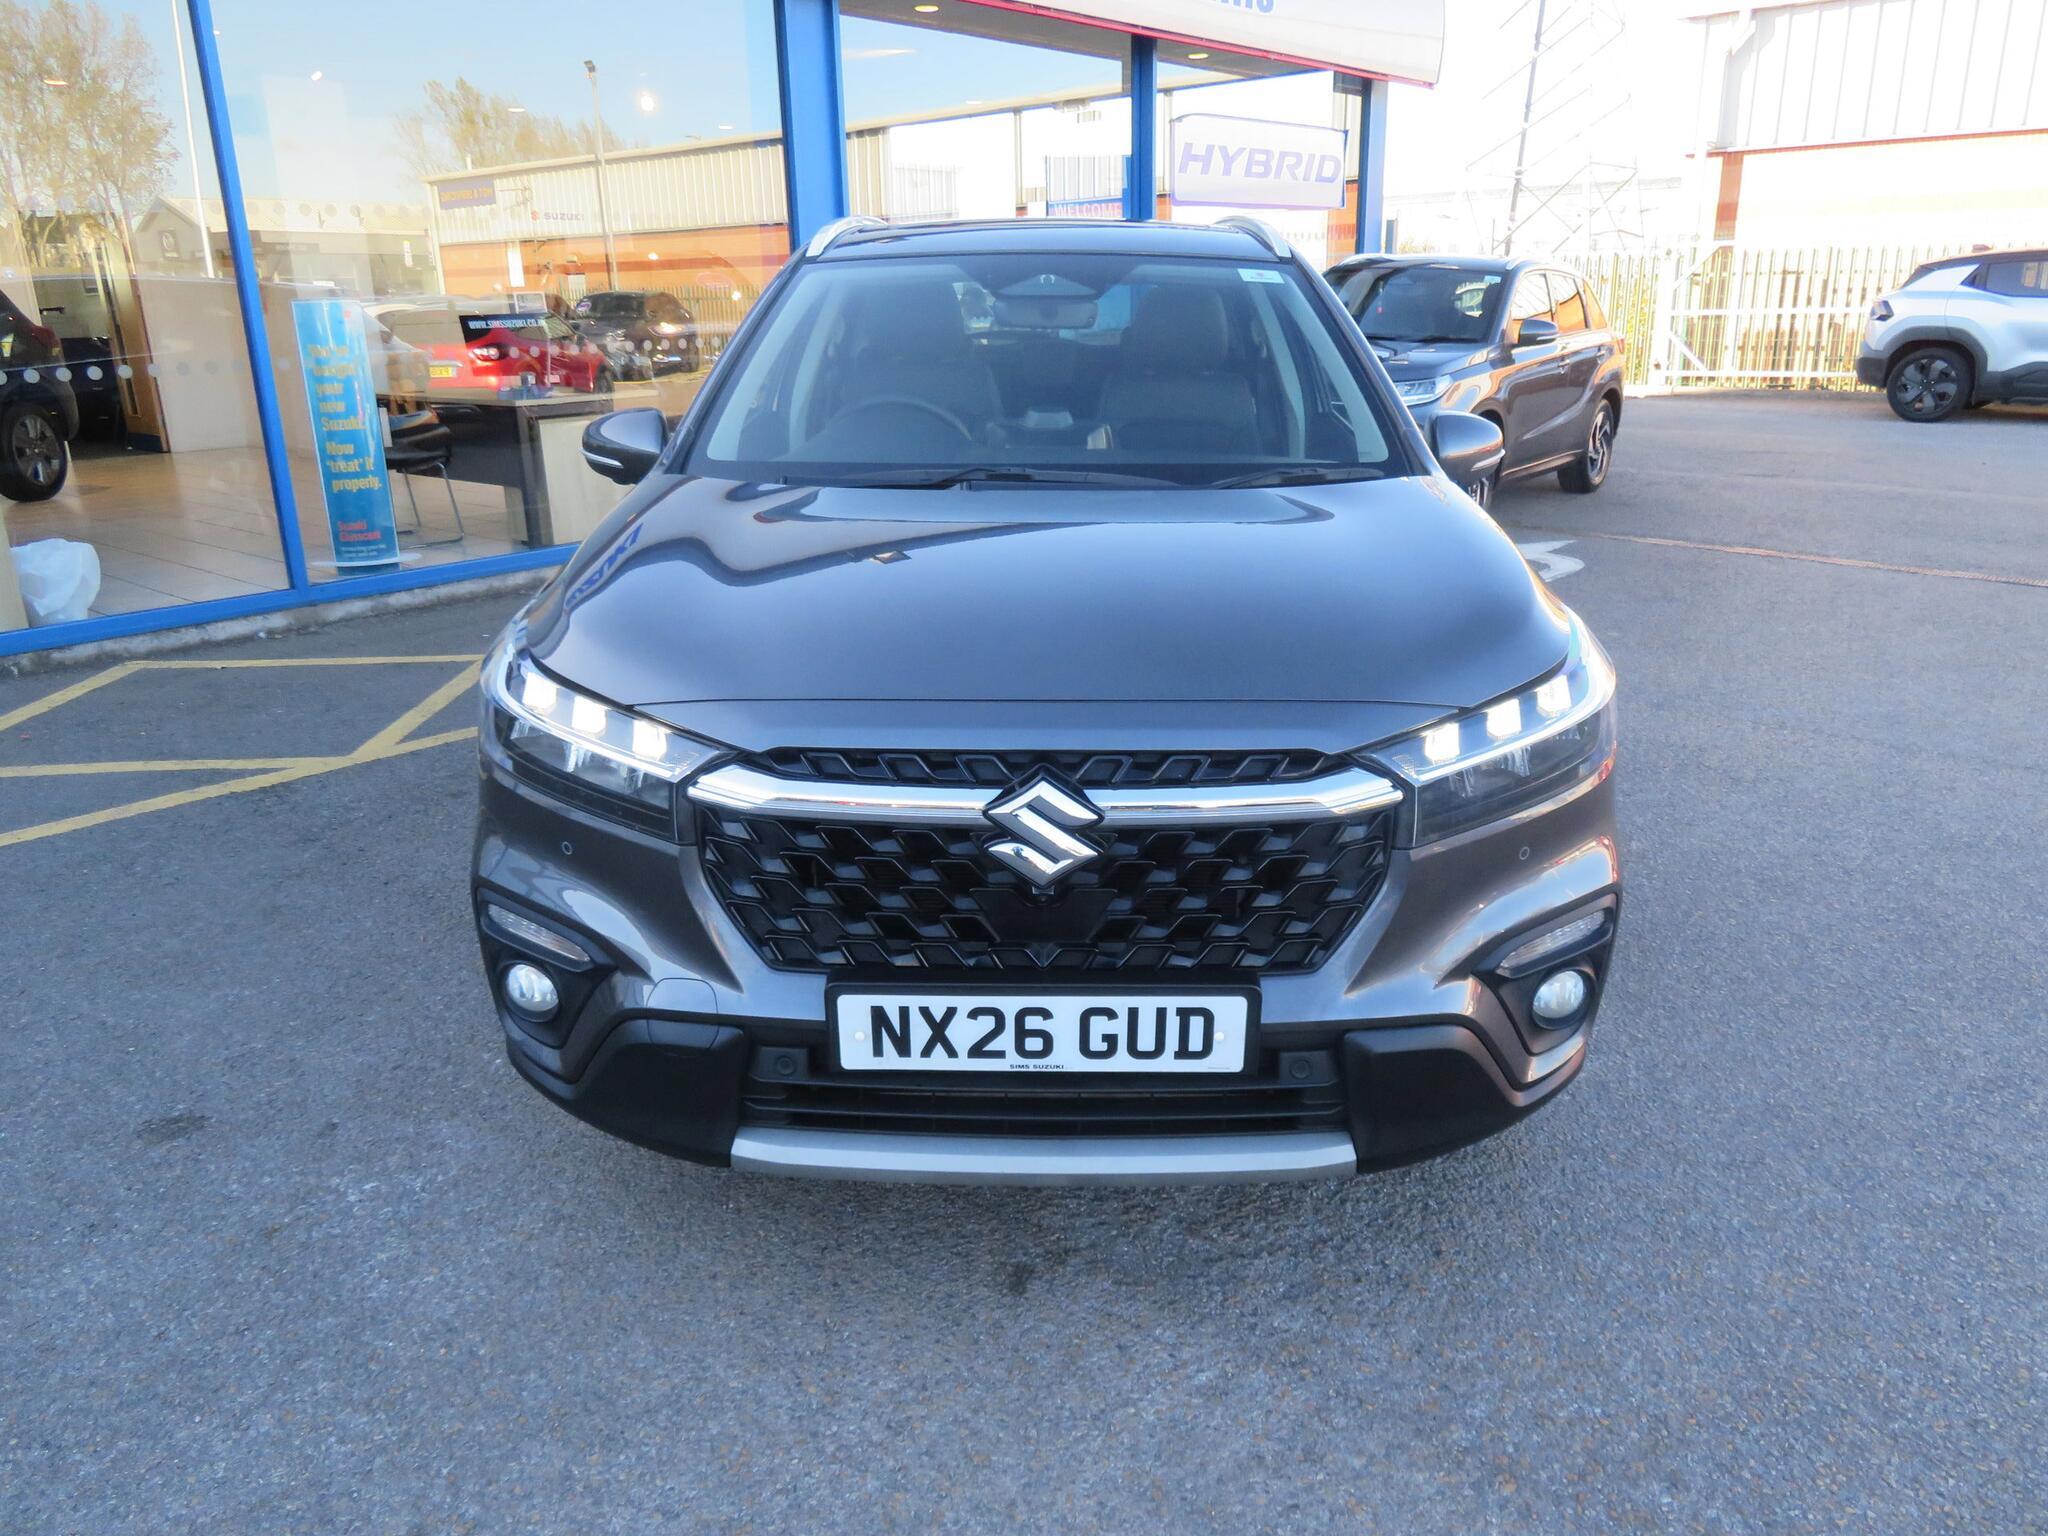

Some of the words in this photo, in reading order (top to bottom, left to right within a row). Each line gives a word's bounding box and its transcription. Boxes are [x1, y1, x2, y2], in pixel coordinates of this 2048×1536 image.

[1178, 142, 1342, 183] HYBRID
[543, 211, 585, 221] SUZUKI
[870, 1005, 1054, 1059] NX26
[1078, 1006, 1215, 1060] GUD
